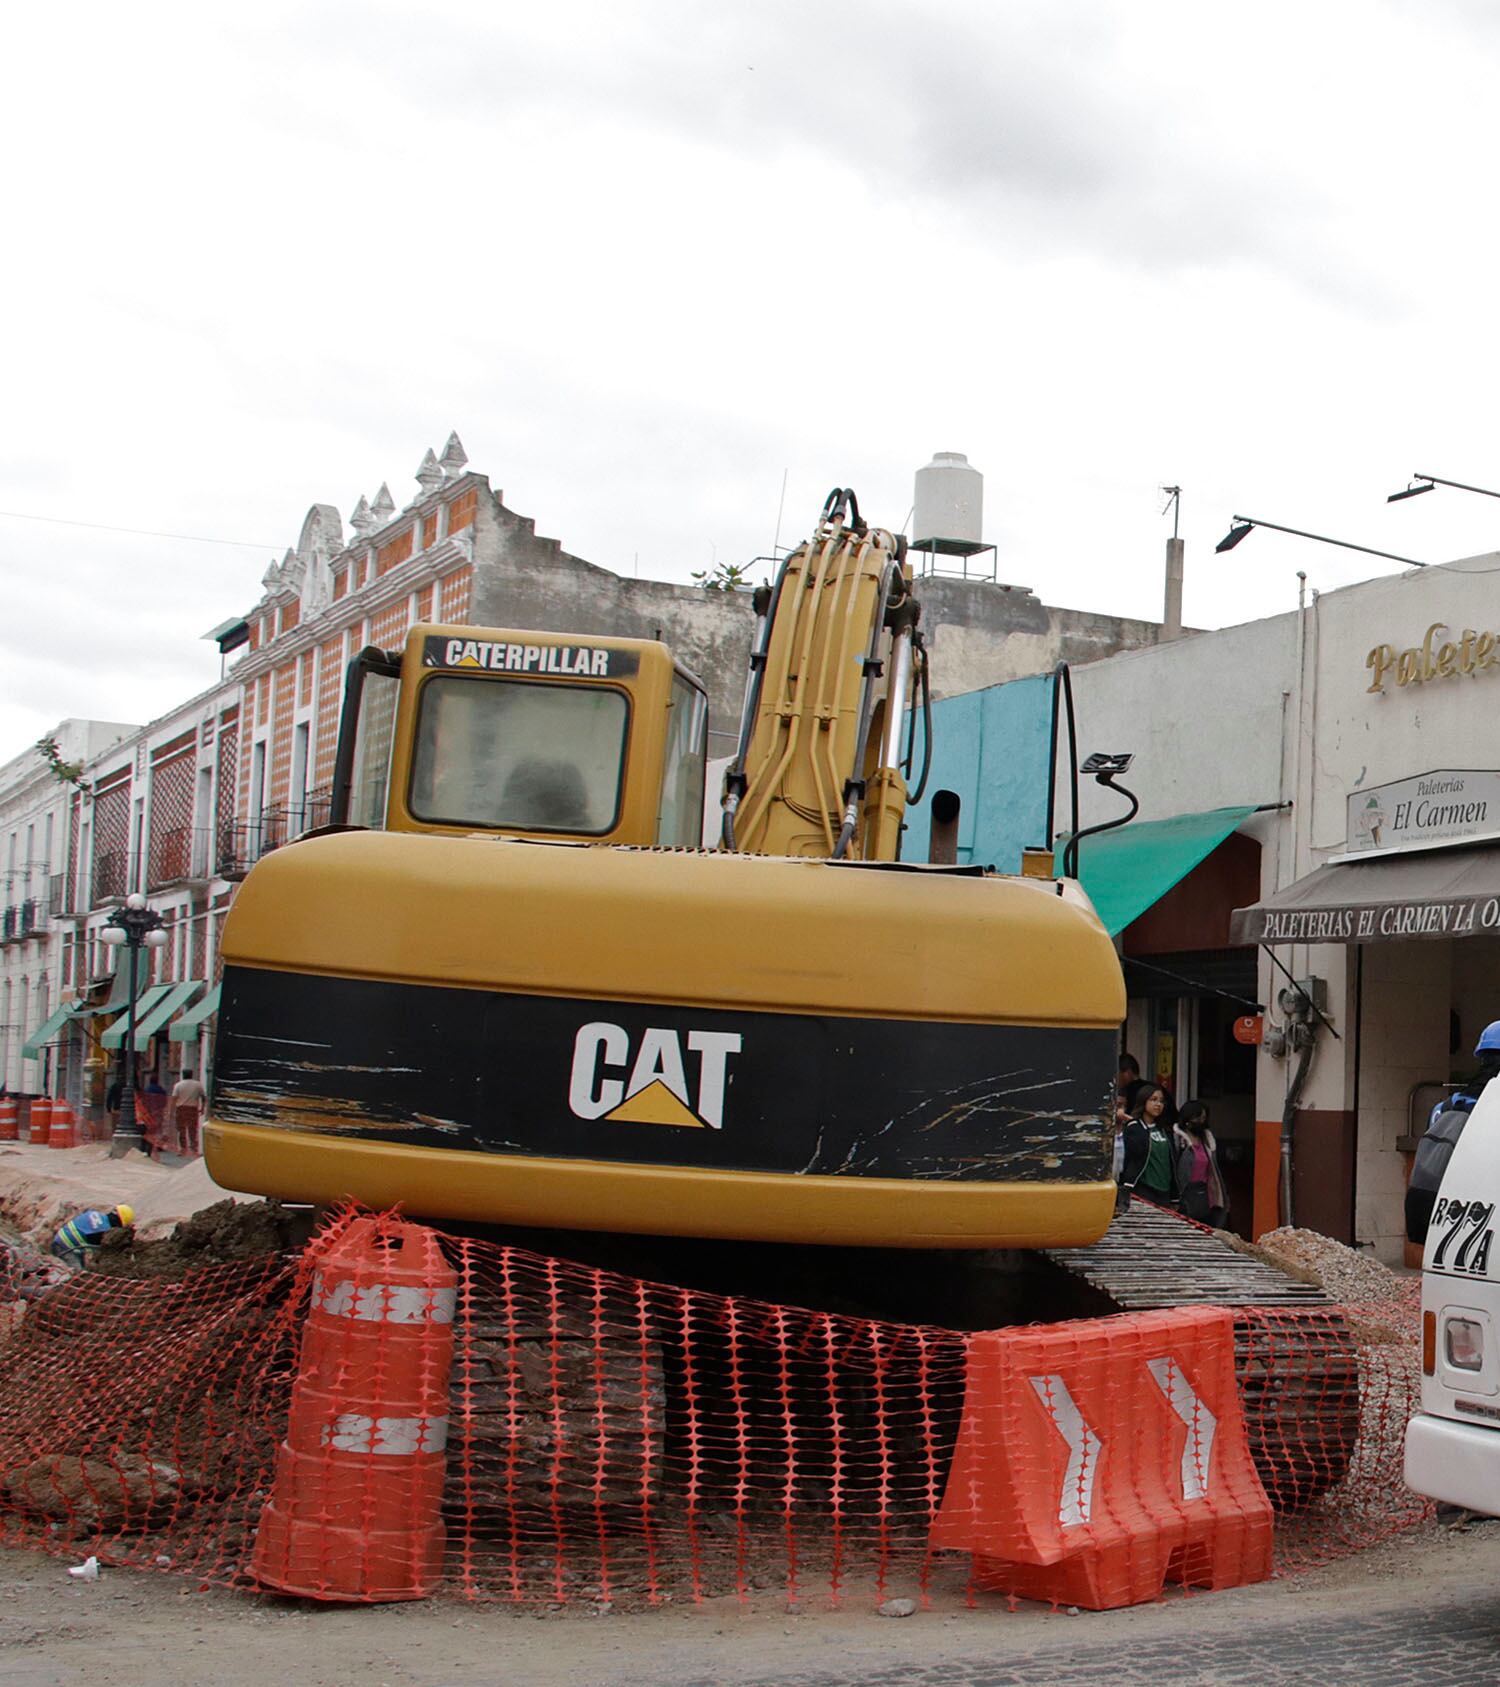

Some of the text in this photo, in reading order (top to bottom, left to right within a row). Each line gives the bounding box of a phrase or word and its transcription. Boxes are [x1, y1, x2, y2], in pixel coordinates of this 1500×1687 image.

[445, 639, 608, 676] CATERPILLAR
[1416, 778, 1465, 797] Paleterías
[1392, 799, 1487, 831] El Carmen
[1261, 908, 1353, 939] PALETERIAS
[1356, 909, 1375, 936] EL
[1380, 904, 1454, 937] CARMEN
[1452, 903, 1477, 931] LA
[569, 1021, 742, 1130] CAT
